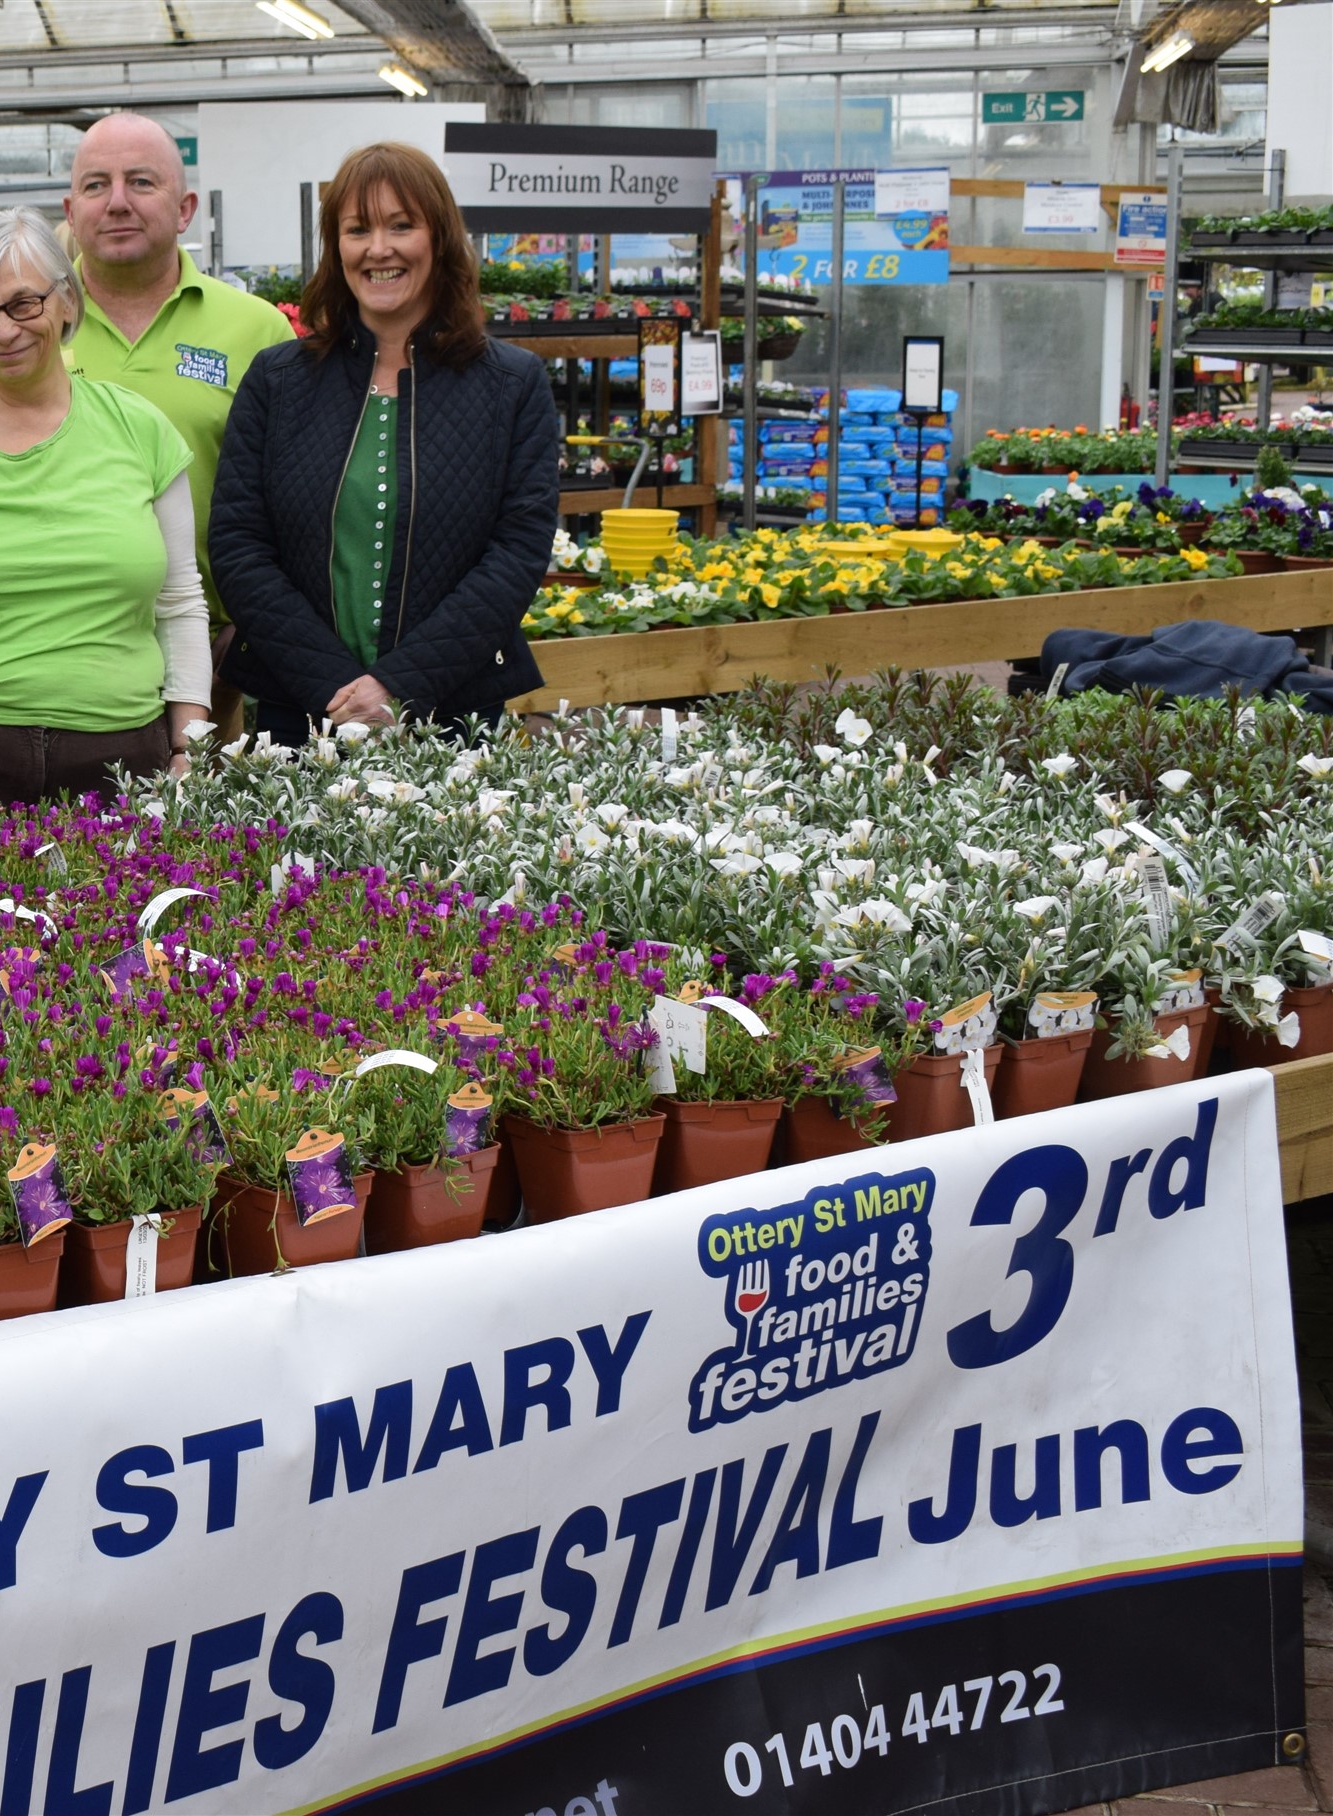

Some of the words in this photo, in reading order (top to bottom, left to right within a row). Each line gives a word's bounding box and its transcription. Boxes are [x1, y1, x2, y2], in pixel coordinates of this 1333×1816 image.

[991, 102, 1013, 114] Exit
[488, 162, 602, 194] Premium
[608, 163, 680, 204] Range
[802, 173, 828, 184] POTS
[895, 219, 928, 230] £4.99
[1122, 205, 1140, 213] Fire
[790, 255, 808, 278] 2
[864, 254, 900, 278] £8
[177, 364, 224, 386] festival
[189, 360, 225, 377] families
[194, 354, 215, 366] food
[218, 360, 224, 369] &
[651, 378, 667, 395] 69p
[708, 1215, 804, 1263] Ottery
[813, 1197, 846, 1233] St
[854, 1180, 927, 1223] Mary
[785, 1232, 878, 1298] food
[891, 1222, 920, 1266] &
[758, 1272, 924, 1348] families
[698, 1302, 917, 1421] festival
[92, 1418, 264, 1558] ST
[309, 1310, 652, 1505] MARY
[907, 1406, 1243, 1545] June
[372, 1411, 883, 1735] FESTIVAL
[723, 1704, 891, 1798] 01404
[901, 1662, 1065, 1745] 44722
